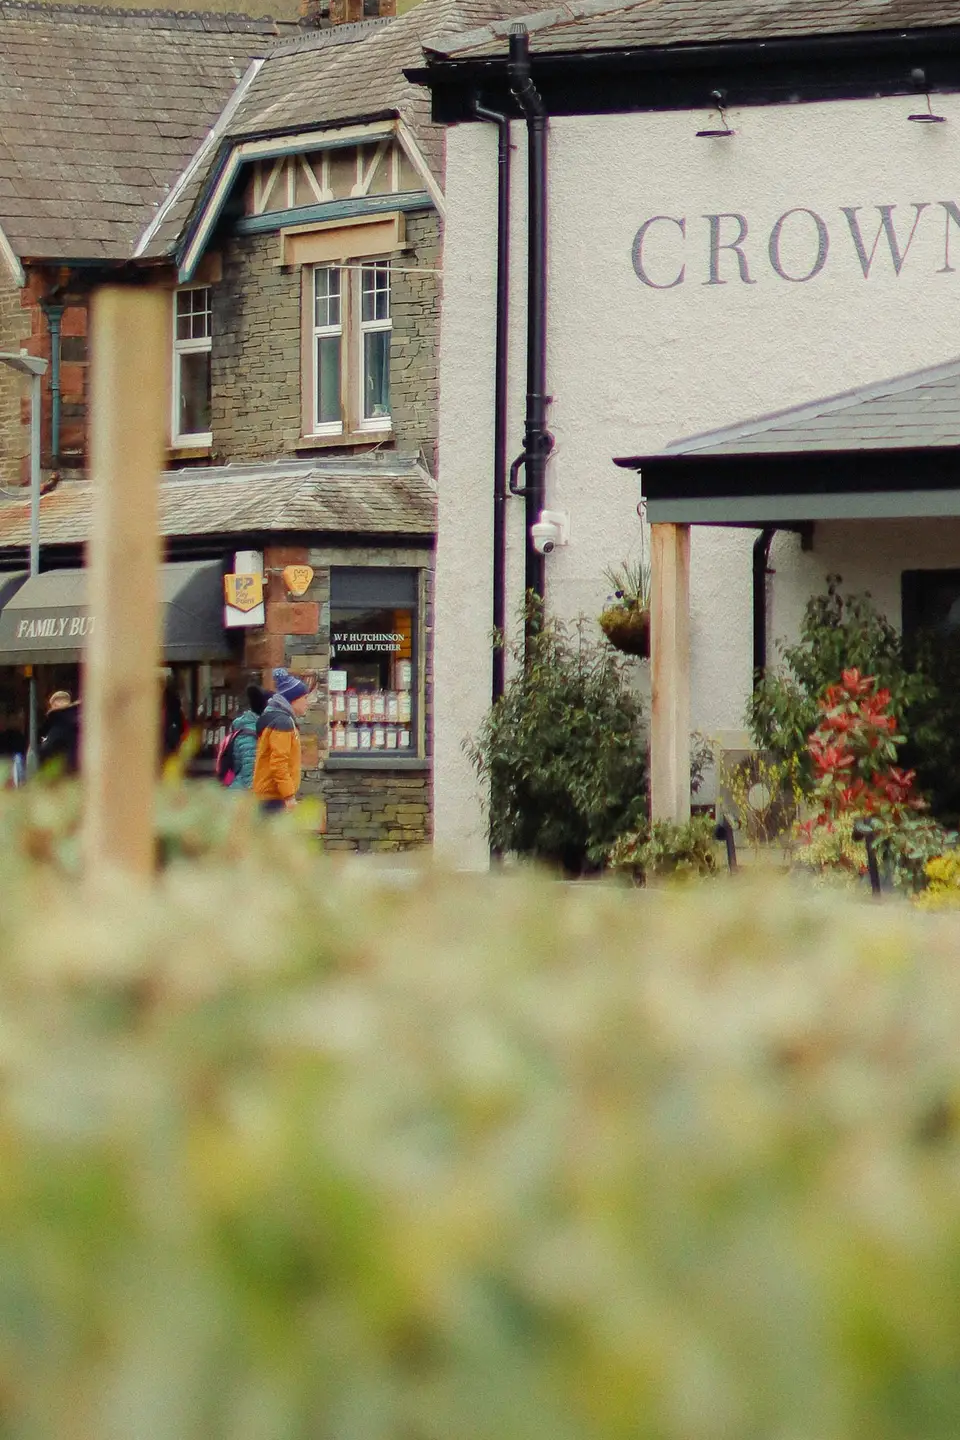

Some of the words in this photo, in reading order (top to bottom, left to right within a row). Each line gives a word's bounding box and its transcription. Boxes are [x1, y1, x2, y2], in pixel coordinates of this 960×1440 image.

[17, 617, 70, 638] FAMILY
[69, 615, 96, 636] BUT
[349, 633, 405, 641] HUTCHINSON
[337, 643, 365, 651] FAMILY
[365, 643, 401, 651] BUTCHER
